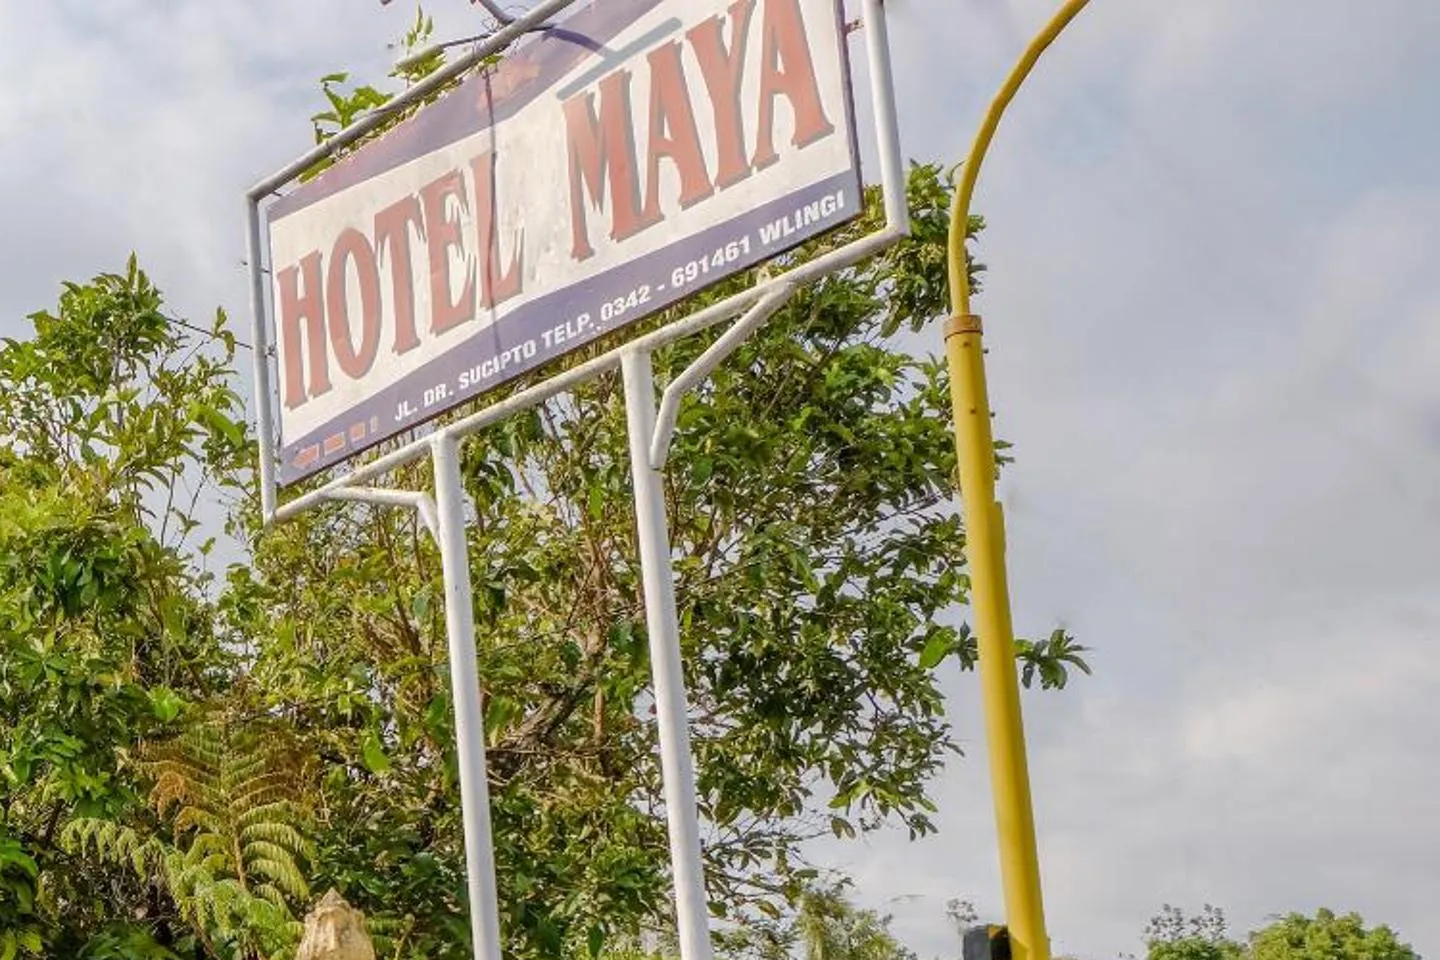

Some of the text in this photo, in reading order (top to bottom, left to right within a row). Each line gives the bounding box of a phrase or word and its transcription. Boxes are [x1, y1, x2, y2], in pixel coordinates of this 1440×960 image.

[276, 0, 836, 411] HOTEL MAYA
[394, 401, 418, 422] JL.
[423, 383, 454, 408] DR.
[458, 340, 537, 390] SUCIPTO
[599, 284, 652, 321] 0342
[671, 235, 751, 288] 691461
[759, 189, 845, 246] WLINGI
